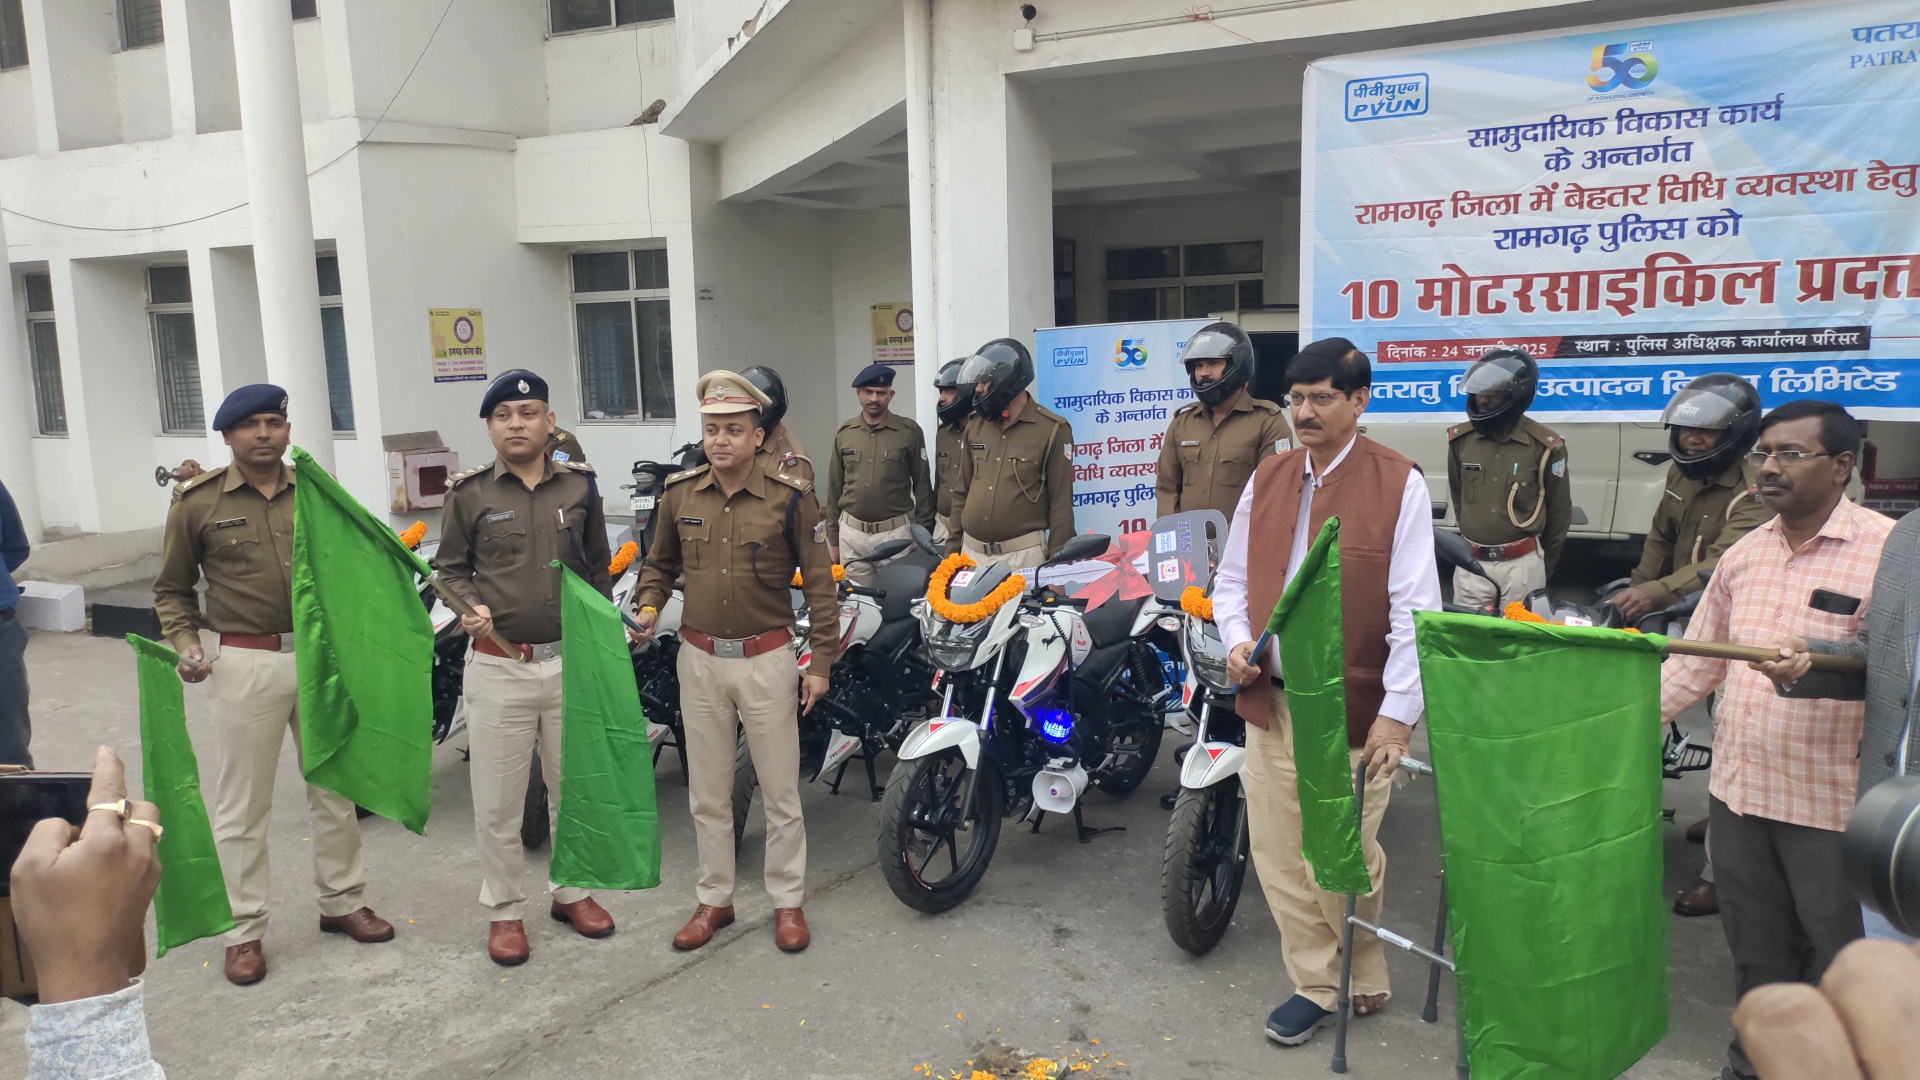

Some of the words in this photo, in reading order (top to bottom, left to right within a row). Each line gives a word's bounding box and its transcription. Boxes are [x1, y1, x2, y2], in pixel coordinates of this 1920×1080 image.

[1585, 42, 1659, 93] 50
[1849, 49, 1920, 69] PATRA
[1352, 98, 1421, 117] PVUN
[1595, 93, 1627, 102] POWERING
[1627, 90, 1655, 98] GROWTH
[1468, 114, 1608, 152] सामुदायिक
[1615, 107, 1711, 136] विकास
[1718, 92, 1786, 126] कार्य
[1544, 146, 1575, 172] के
[1581, 135, 1694, 170] अन्तर्गत
[1355, 199, 1444, 228] रामगढ़
[1450, 190, 1522, 219] जिला
[1529, 181, 1560, 212] में
[1563, 182, 1652, 210] बेहतर
[1657, 171, 1727, 205] विधि
[1735, 168, 1858, 198] व्यवस्था
[1866, 160, 1920, 198] हेतु
[1492, 223, 1591, 254] रामगढ़
[1597, 213, 1689, 253] पुलिस
[1696, 208, 1743, 238] को
[1340, 279, 1400, 321] 10
[1415, 251, 1781, 318] मोटरसाइकिल
[1387, 344, 1427, 359] दिनांक
[1441, 345, 1459, 357] 24
[1511, 342, 1548, 355] 025
[1575, 339, 1609, 354] स्थान
[1626, 334, 1668, 356] पुलिस
[1673, 334, 1736, 352] अधिक्षक
[1742, 330, 1806, 349] कार्यालय
[1812, 328, 1860, 346] परिसर
[1056, 357, 1085, 365] PVUN
[1536, 375, 1653, 397] उत्पादन
[1770, 366, 1901, 393] लिमिटेड
[1054, 390, 1126, 412] सामुदायिक
[1129, 387, 1173, 404] विकास
[1095, 409, 1110, 424] के
[1114, 405, 1167, 423] अन्तर्गत
[1107, 437, 1145, 454] जिला
[1149, 432, 1165, 450] में
[1124, 484, 1155, 507] पुलि
[1178, 519, 1193, 553] TVS
